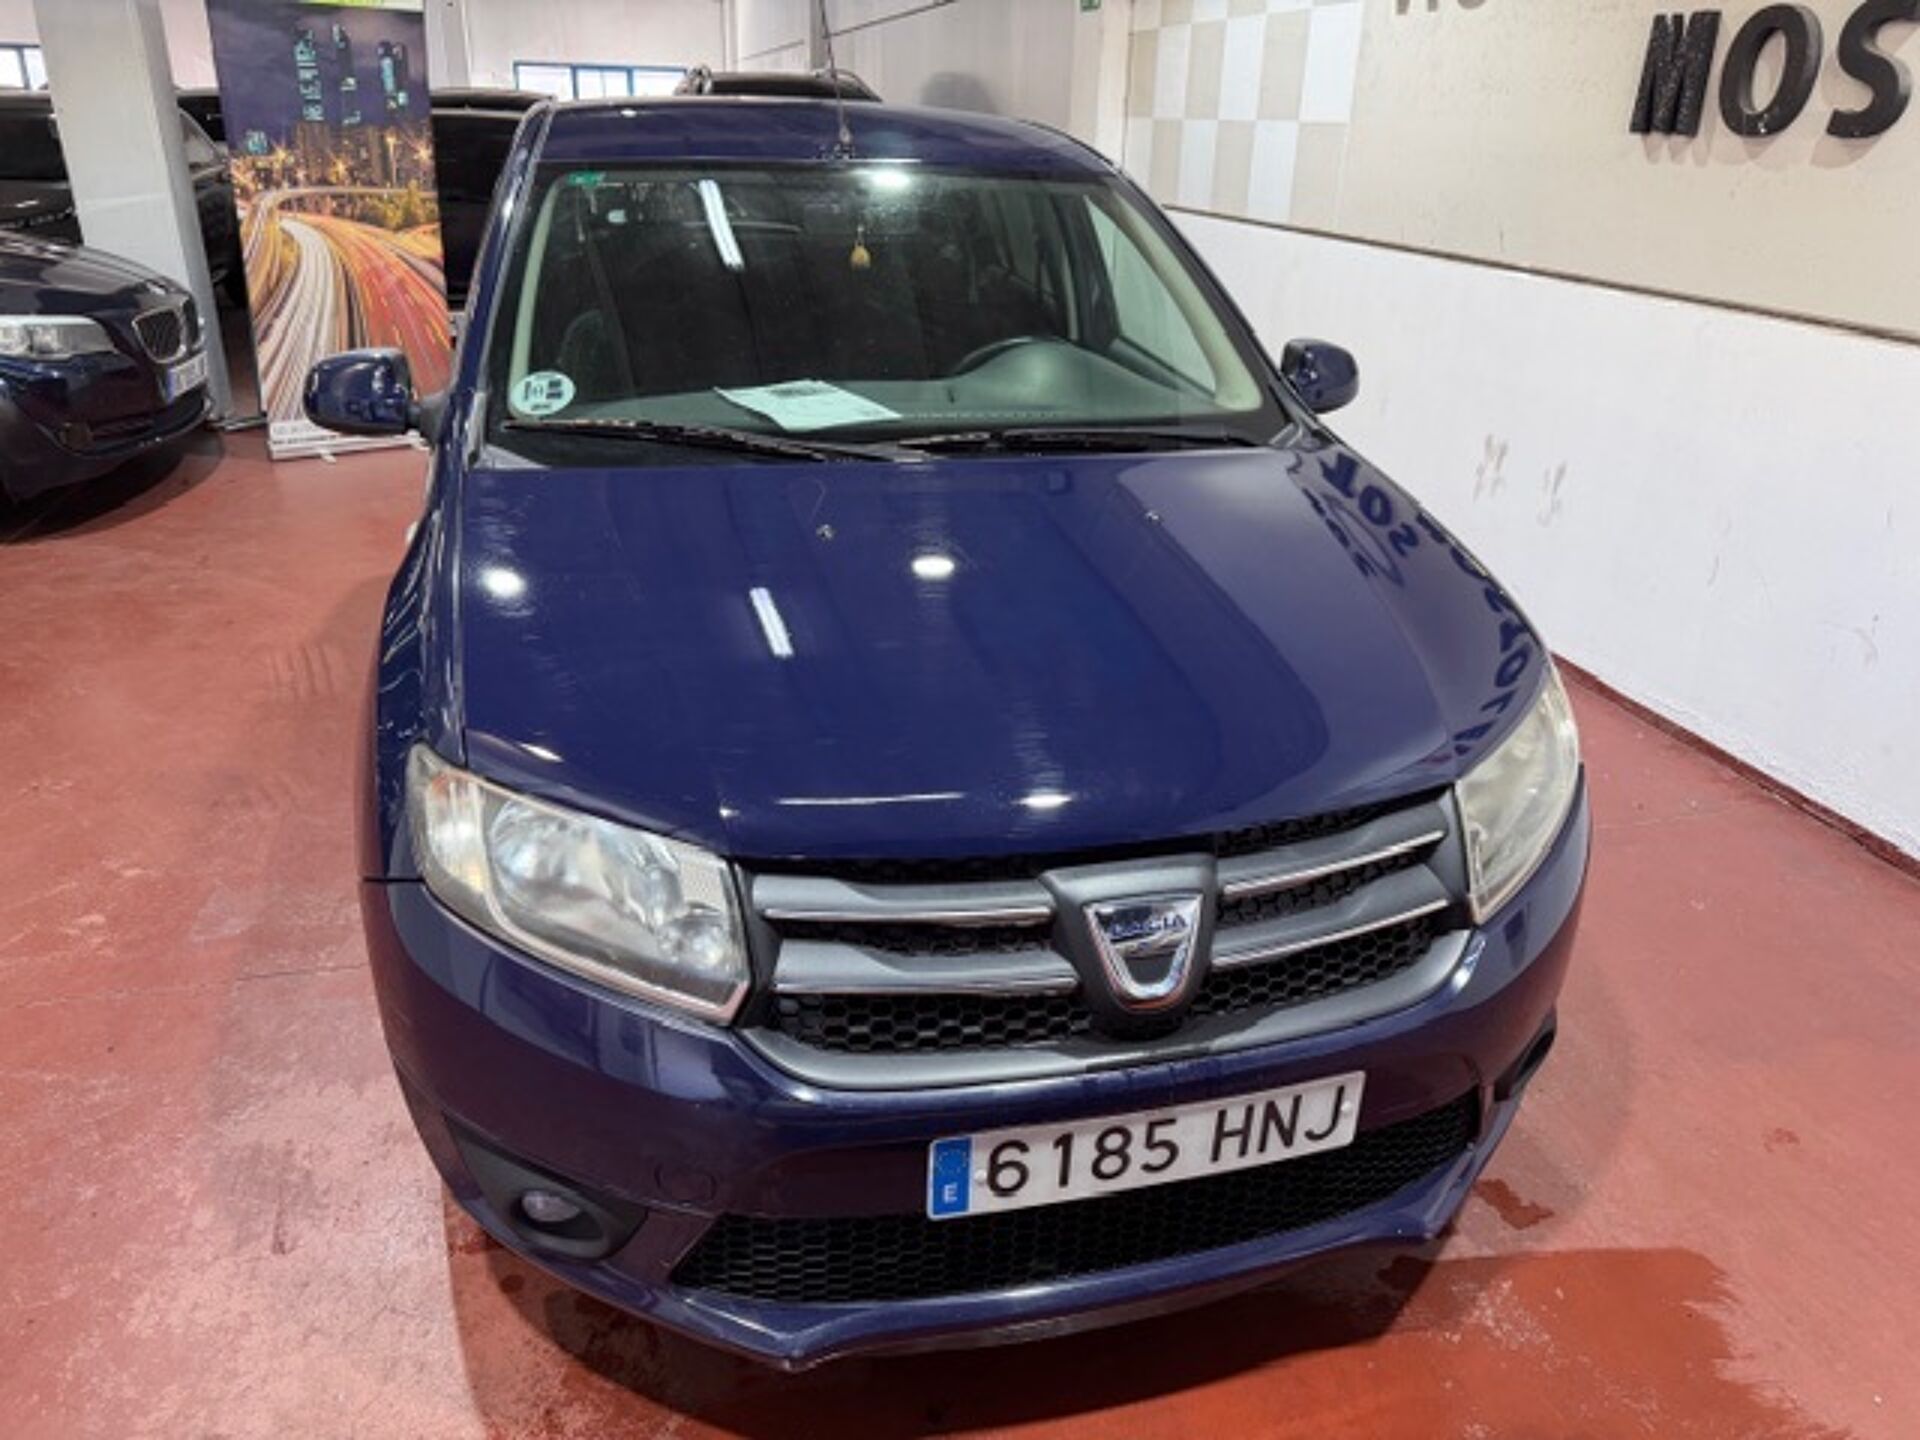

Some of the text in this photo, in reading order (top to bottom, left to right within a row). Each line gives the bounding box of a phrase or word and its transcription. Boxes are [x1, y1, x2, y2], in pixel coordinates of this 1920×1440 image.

[985, 1085, 1346, 1198] 6185 HNJ
[942, 1184, 958, 1203] E
